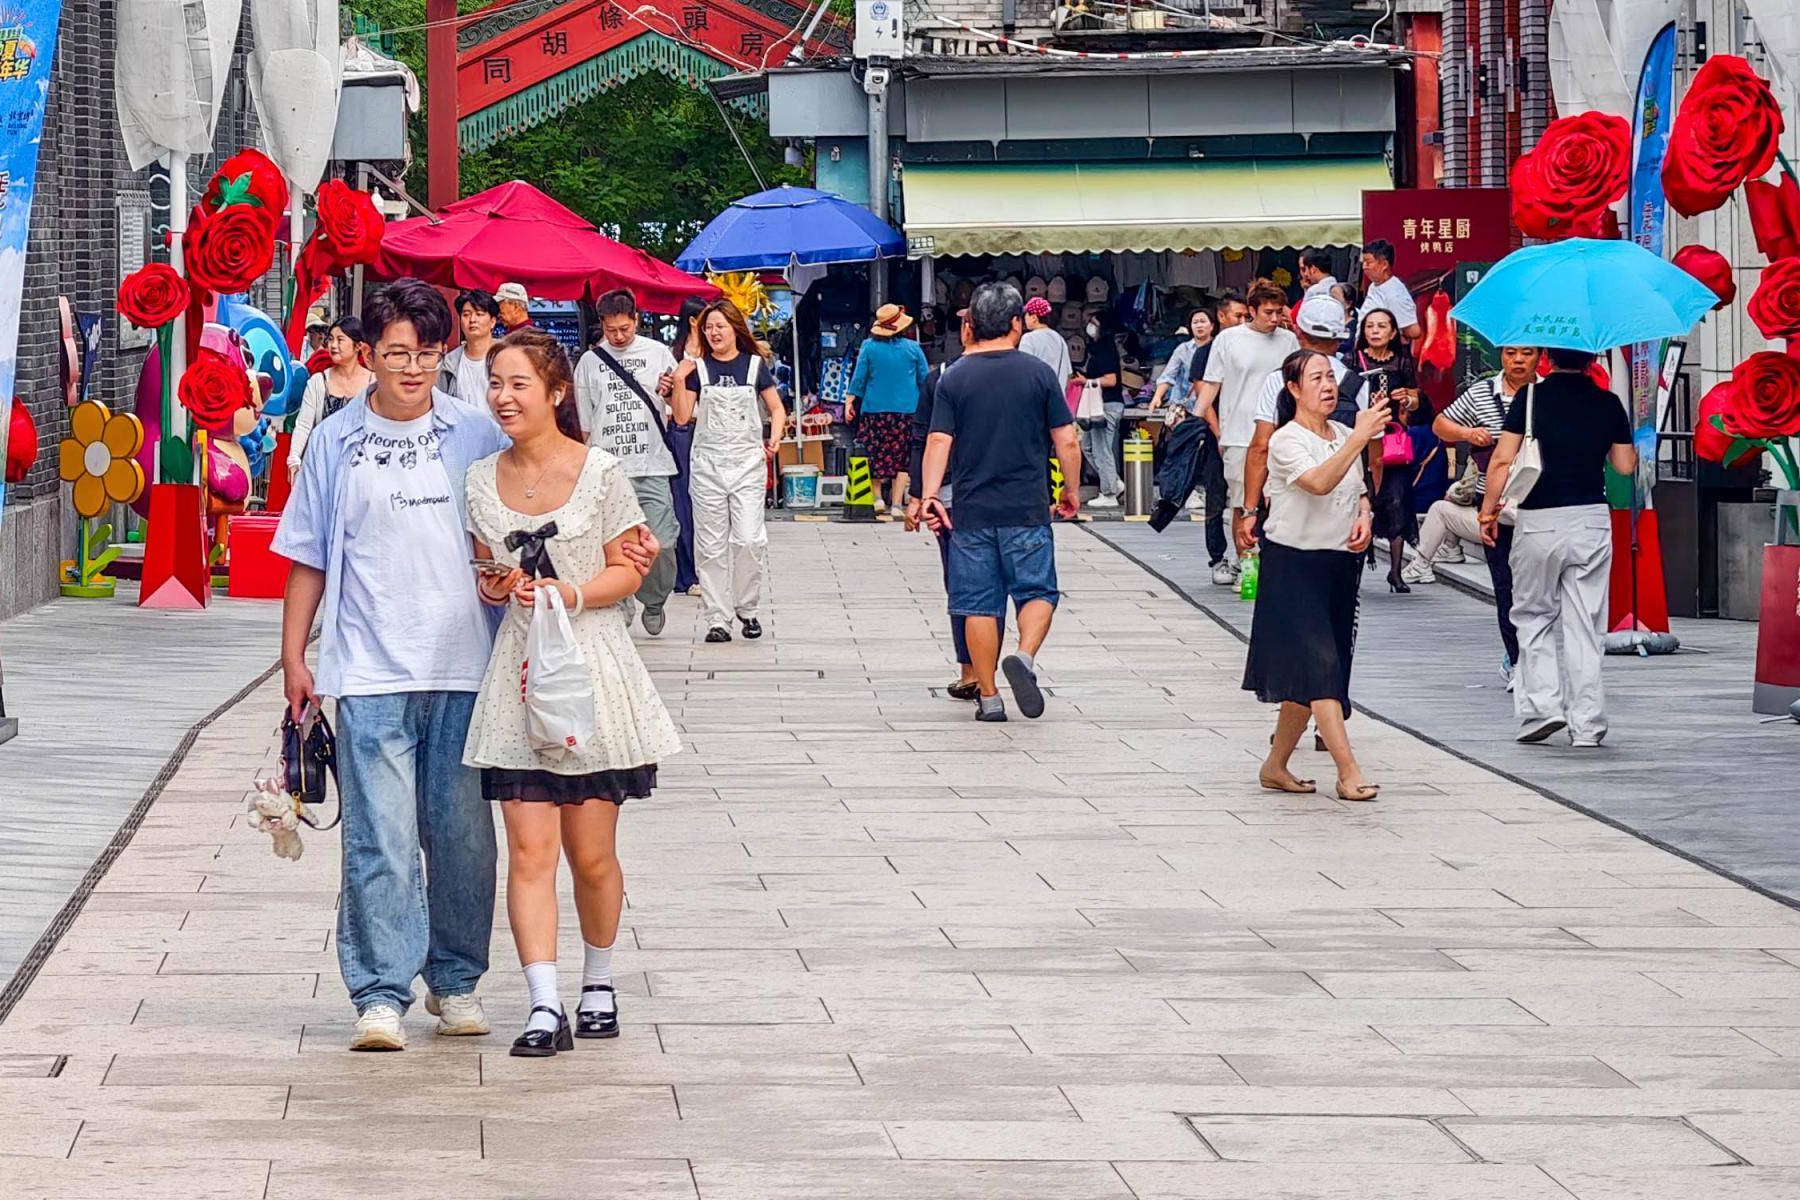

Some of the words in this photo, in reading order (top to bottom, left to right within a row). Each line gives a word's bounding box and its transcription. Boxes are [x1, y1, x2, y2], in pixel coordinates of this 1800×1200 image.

[1402, 217, 1471, 240] 青年星厨
[1420, 241, 1454, 254] 烤鸭店
[605, 400, 643, 414] SOLITUDE
[616, 412, 633, 422] EGO
[602, 422, 649, 436] PERPLEXION
[614, 434, 637, 445] CLUB
[622, 444, 633, 455] OF
